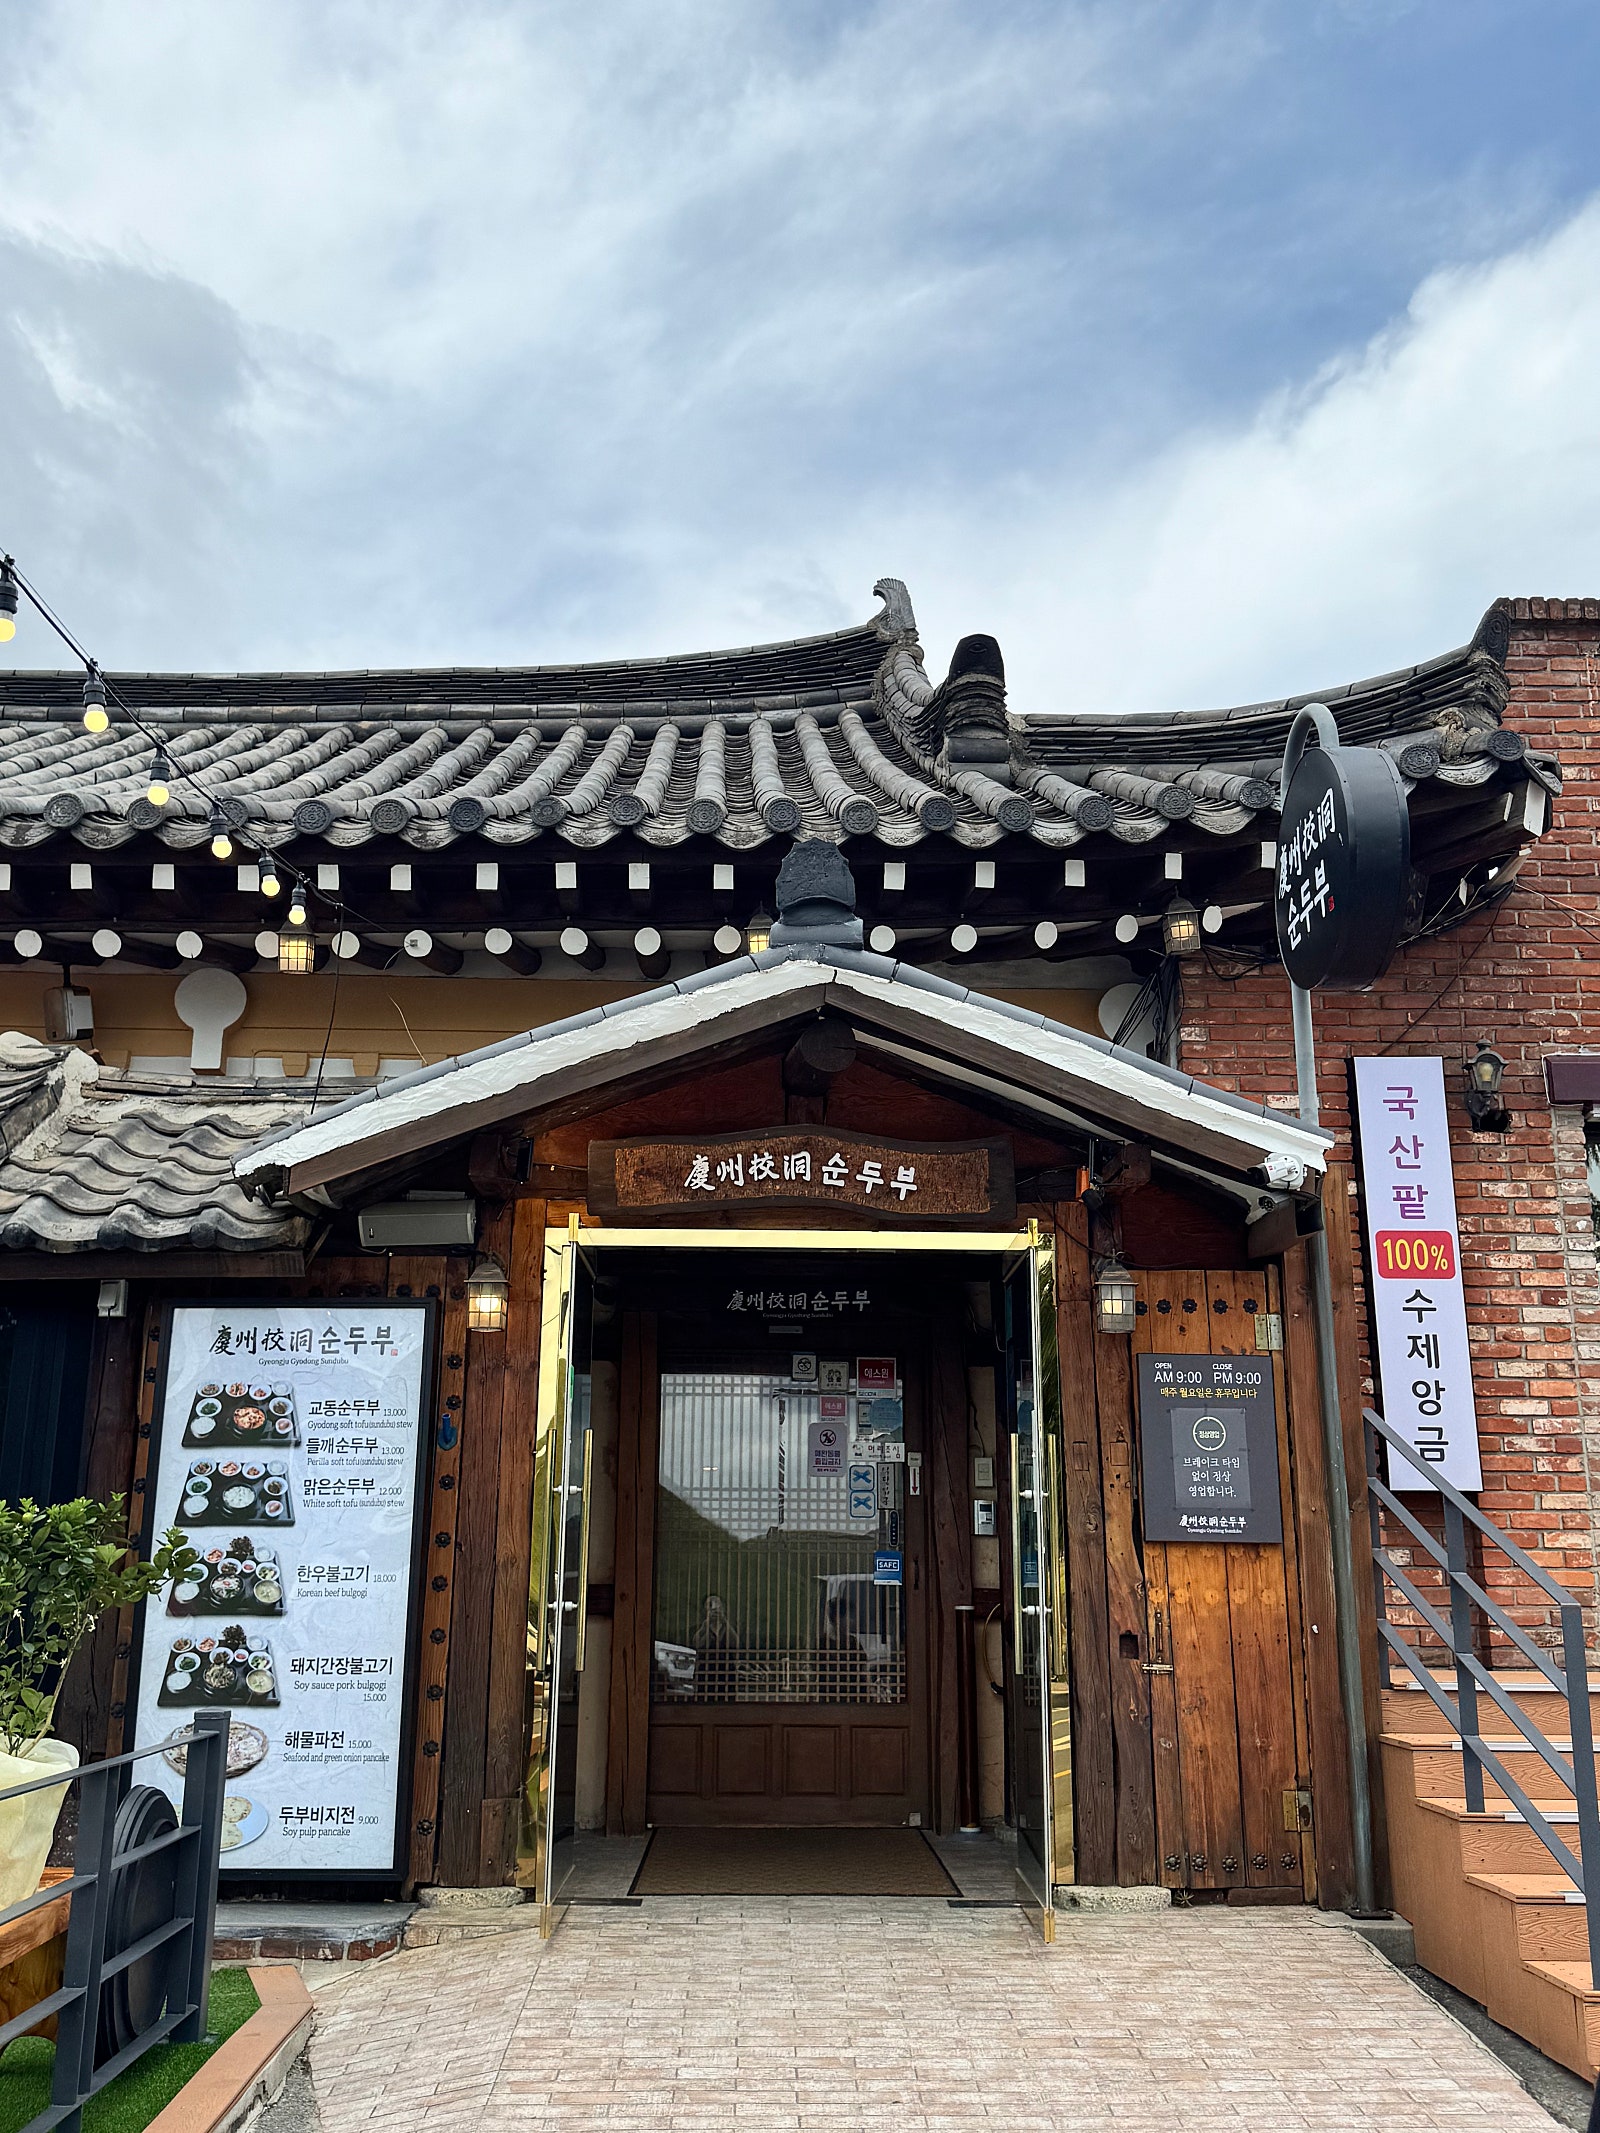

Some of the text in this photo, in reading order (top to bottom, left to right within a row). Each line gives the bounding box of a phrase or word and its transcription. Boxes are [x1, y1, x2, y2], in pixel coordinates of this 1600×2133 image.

[1287, 859, 1330, 951] 순두부
[1382, 1237, 1448, 1272] 100%
[258, 1357, 290, 1365] Gyeongju
[320, 1357, 349, 1365] Sundubu
[1154, 1371, 1262, 1384] AM 9:00 PM 9:00
[1160, 1387, 1258, 1399] 매주 월요일은 휴무입니다
[308, 1400, 381, 1417] 교동순두부
[307, 1420, 339, 1430] Gyodong
[340, 1420, 354, 1429] soft
[306, 1437, 378, 1454] 들깨순두부
[307, 1457, 329, 1466] Perilla
[331, 1457, 344, 1466] soft
[1183, 1456, 1220, 1468] 브레이크
[1191, 1470, 1232, 1482] 없이 정상
[303, 1478, 375, 1496] 맑은순두부
[1188, 1485, 1237, 1498] 영업합니다.
[303, 1499, 325, 1508] White
[326, 1498, 343, 1508] soft
[386, 1499, 405, 1507] stew
[297, 1565, 370, 1583] 한우불고기
[297, 1587, 368, 1599] Korean beef bulgogi
[290, 1657, 393, 1675] 돼지간장불고기
[293, 1680, 387, 1692] Soy sauce pork bulgogi
[284, 1730, 345, 1749] 해물파전
[283, 1752, 390, 1764] Seafood and green onion pancake
[279, 1806, 355, 1825] 두부비지전
[282, 1826, 351, 1838] Soy pulp pancake
